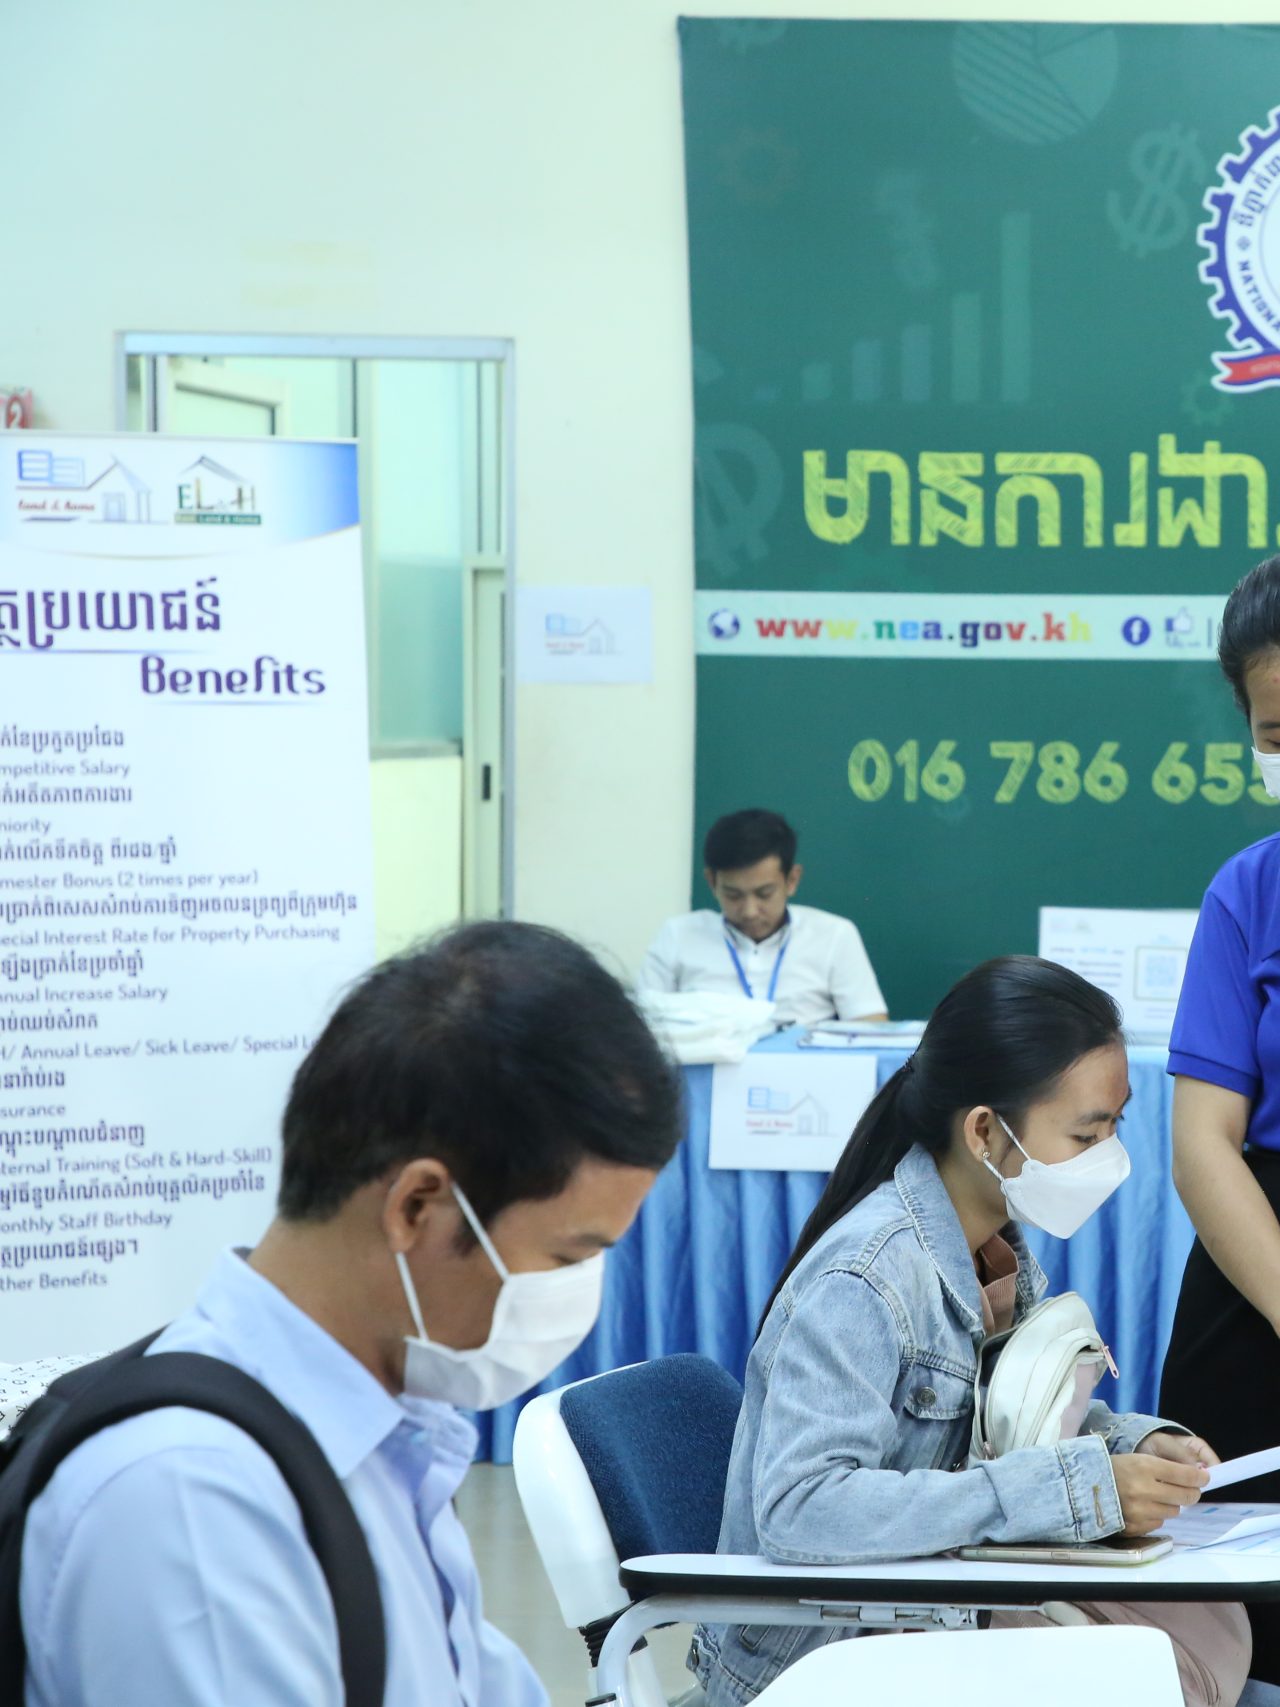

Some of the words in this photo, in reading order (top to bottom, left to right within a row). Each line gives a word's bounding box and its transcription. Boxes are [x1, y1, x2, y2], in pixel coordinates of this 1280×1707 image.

[755, 611, 1092, 648] www.nea.gov.kh
[141, 654, 327, 695] Benefits
[80, 760, 130, 779] Salary
[847, 738, 966, 802] 016
[989, 741, 1129, 804] 786
[63, 872, 113, 888] Bonus
[138, 871, 183, 886] times
[188, 874, 213, 889] per
[219, 869, 259, 888] year)
[43, 929, 107, 945] Interest
[112, 927, 148, 943] Rate
[153, 925, 175, 942] for
[180, 926, 251, 945] Property
[254, 924, 341, 942] Purchasing
[45, 986, 113, 1002] Increase
[117, 983, 168, 1001] Salary
[21, 1043, 79, 1060] Annual
[145, 1038, 178, 1056] Sick
[243, 1035, 298, 1055] Special
[56, 1156, 120, 1174] Training
[125, 1152, 163, 1170] (Soft
[169, 1151, 181, 1167] &
[1, 1216, 54, 1235] onthly
[59, 1211, 98, 1231] Staff
[104, 1209, 173, 1228] Birthday
[40, 1269, 108, 1289] Benefits
